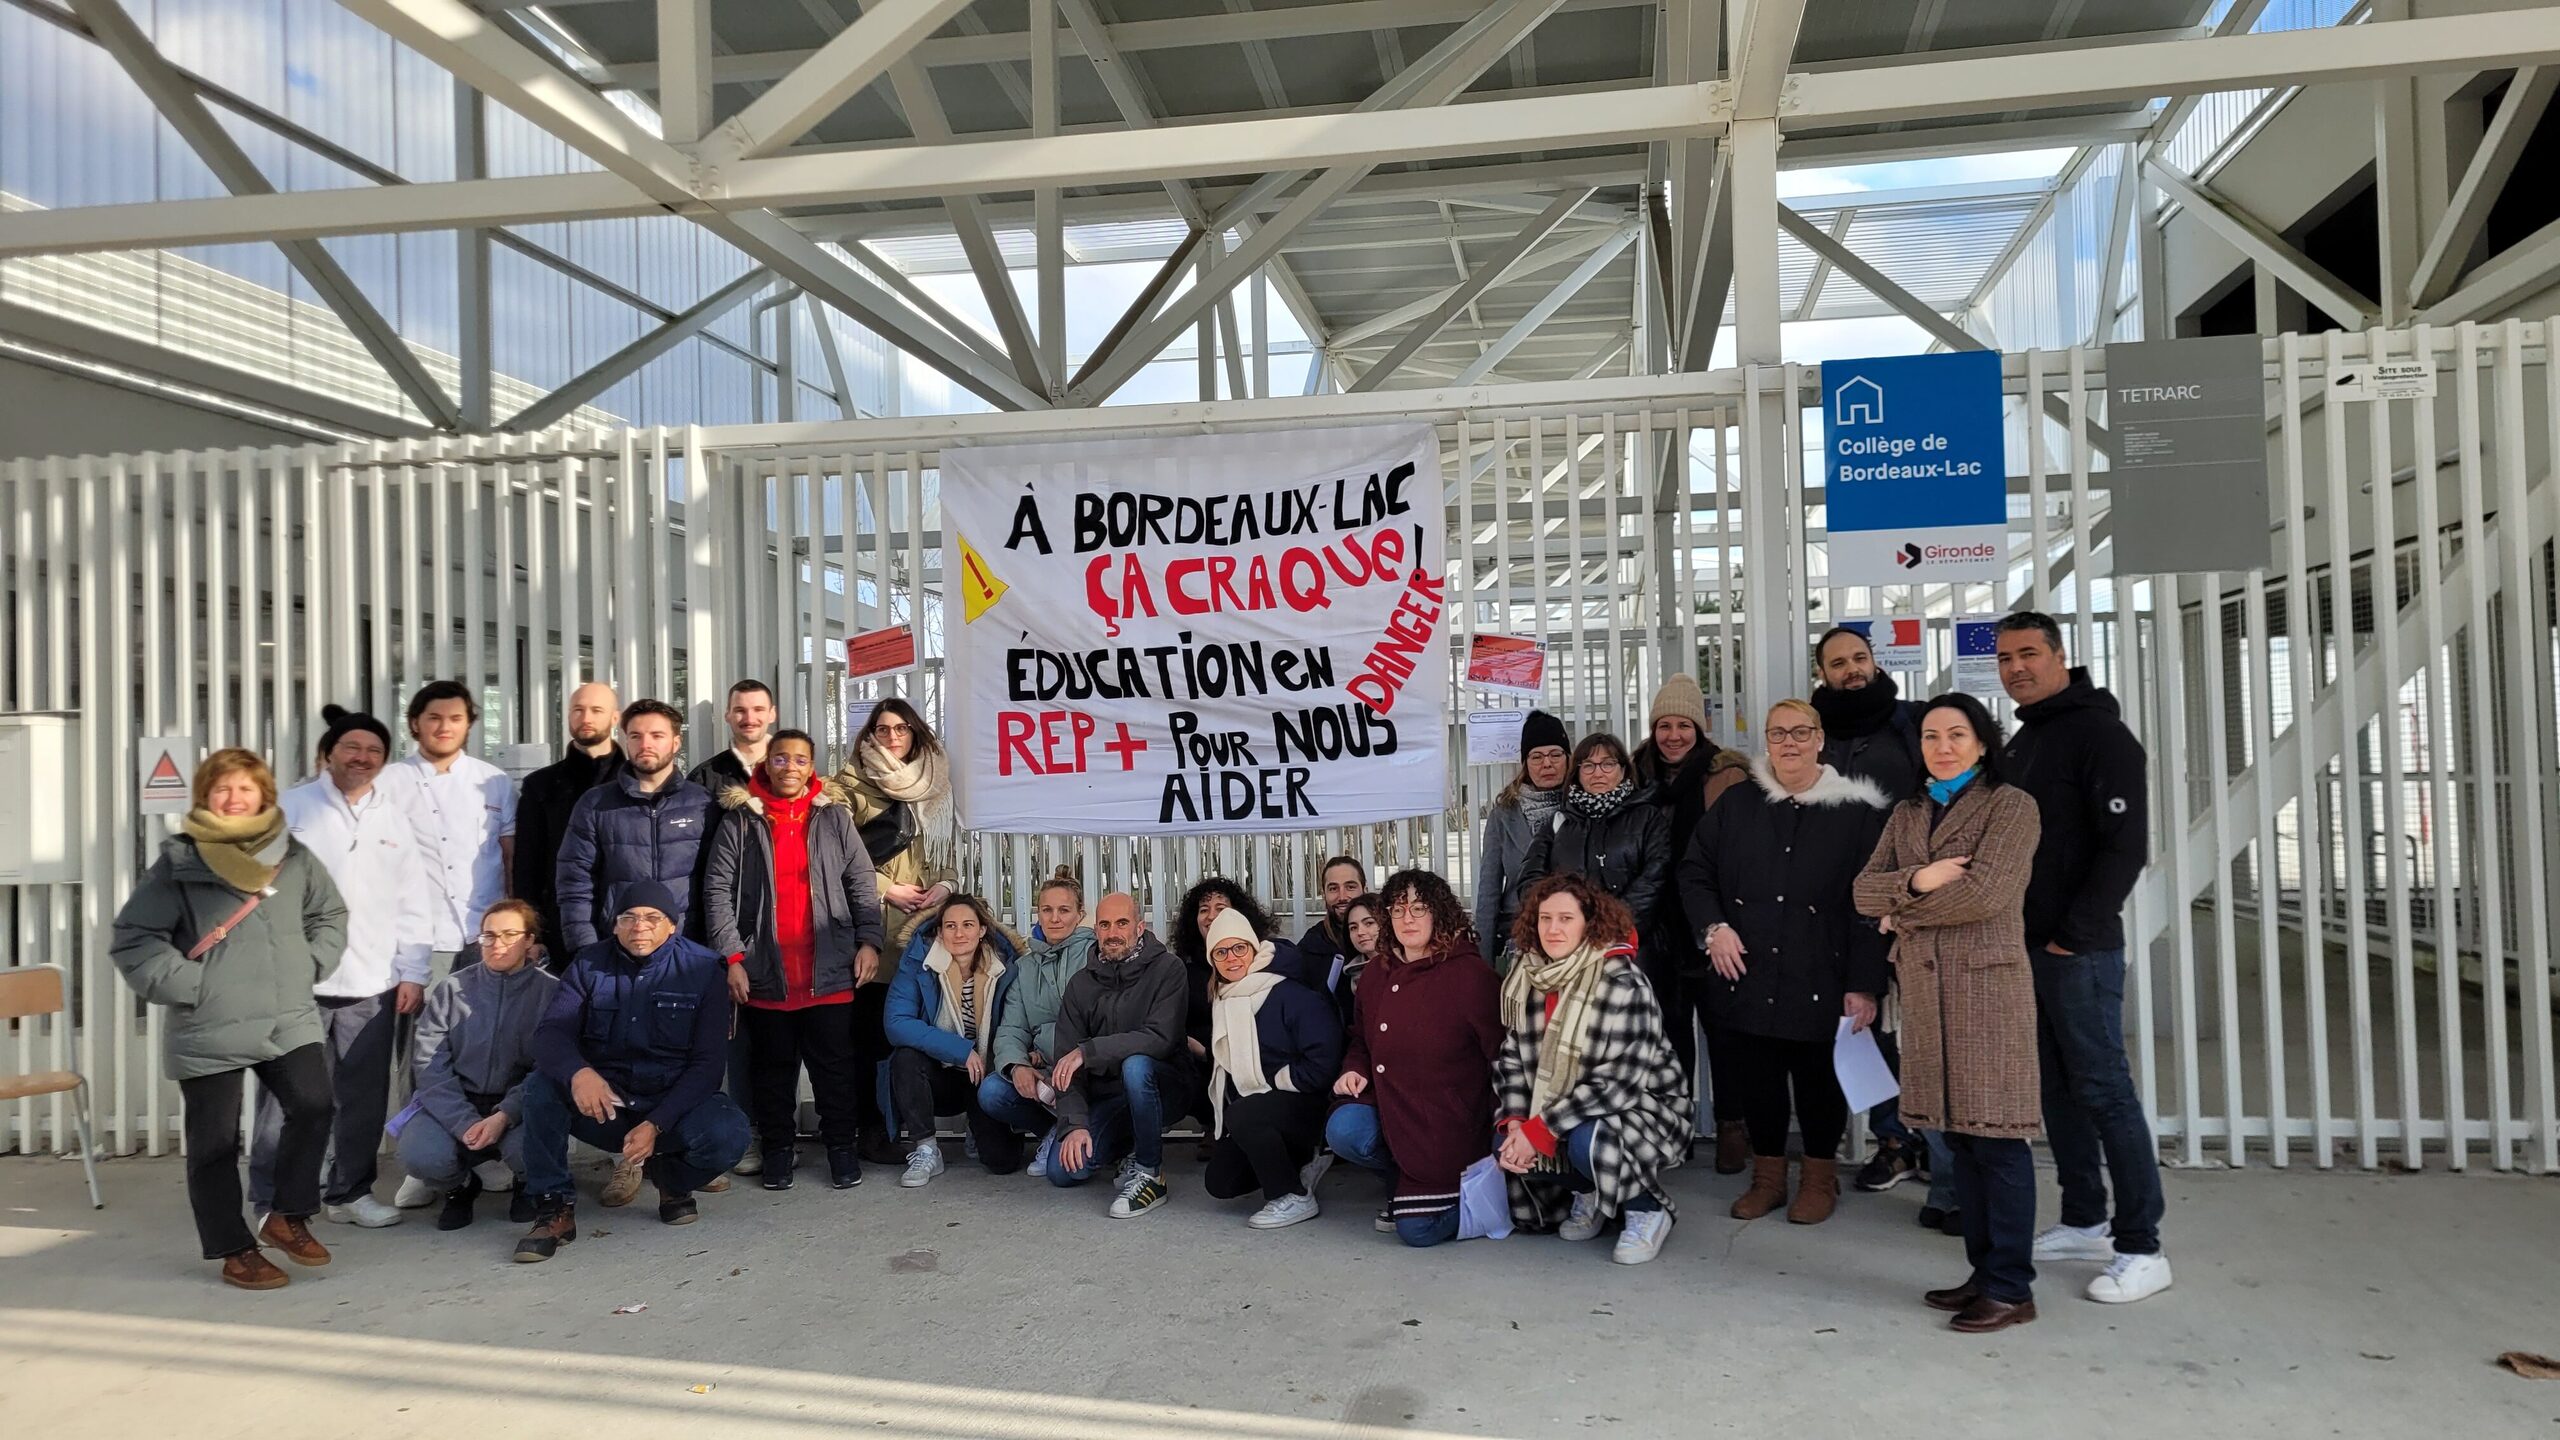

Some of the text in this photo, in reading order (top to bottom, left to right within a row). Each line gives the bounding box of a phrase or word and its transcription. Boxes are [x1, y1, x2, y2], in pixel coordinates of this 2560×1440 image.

[2118, 384, 2202, 404] TETRARC
[1838, 433, 1949, 457] Collège de
[1840, 460, 1983, 482] Bordeaux-Lac
[1004, 461, 1416, 555] À BORDEAUX-LAC
[1924, 543, 1996, 559] Gironde
[1085, 552, 1157, 638] ÇA
[1345, 567, 1445, 716] DANGER
[1272, 697, 1398, 764] NOUS
